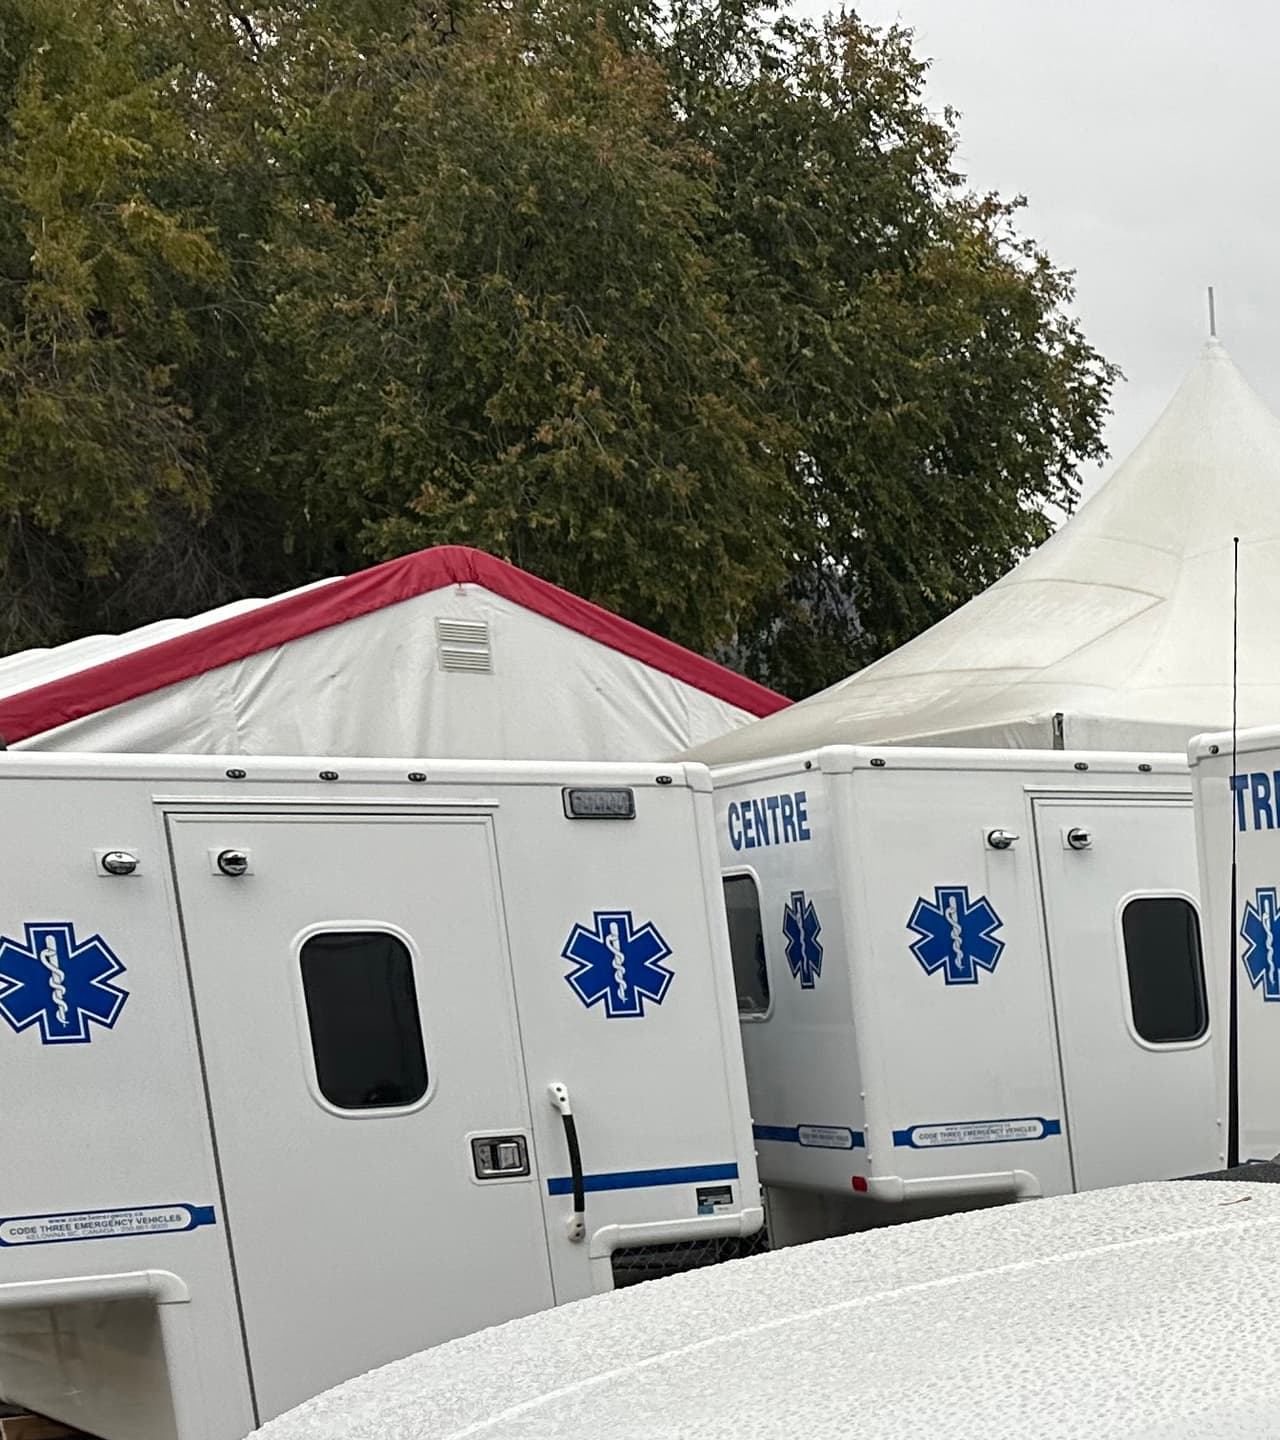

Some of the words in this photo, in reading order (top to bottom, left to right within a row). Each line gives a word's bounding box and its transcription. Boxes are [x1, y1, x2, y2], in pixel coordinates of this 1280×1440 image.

[728, 791, 811, 851] CENTRE
[9, 1227, 37, 1236] CODE
[40, 1224, 72, 1233] THREE
[74, 1218, 133, 1230] EMERGENCY
[135, 1214, 182, 1225] VEHICLES
